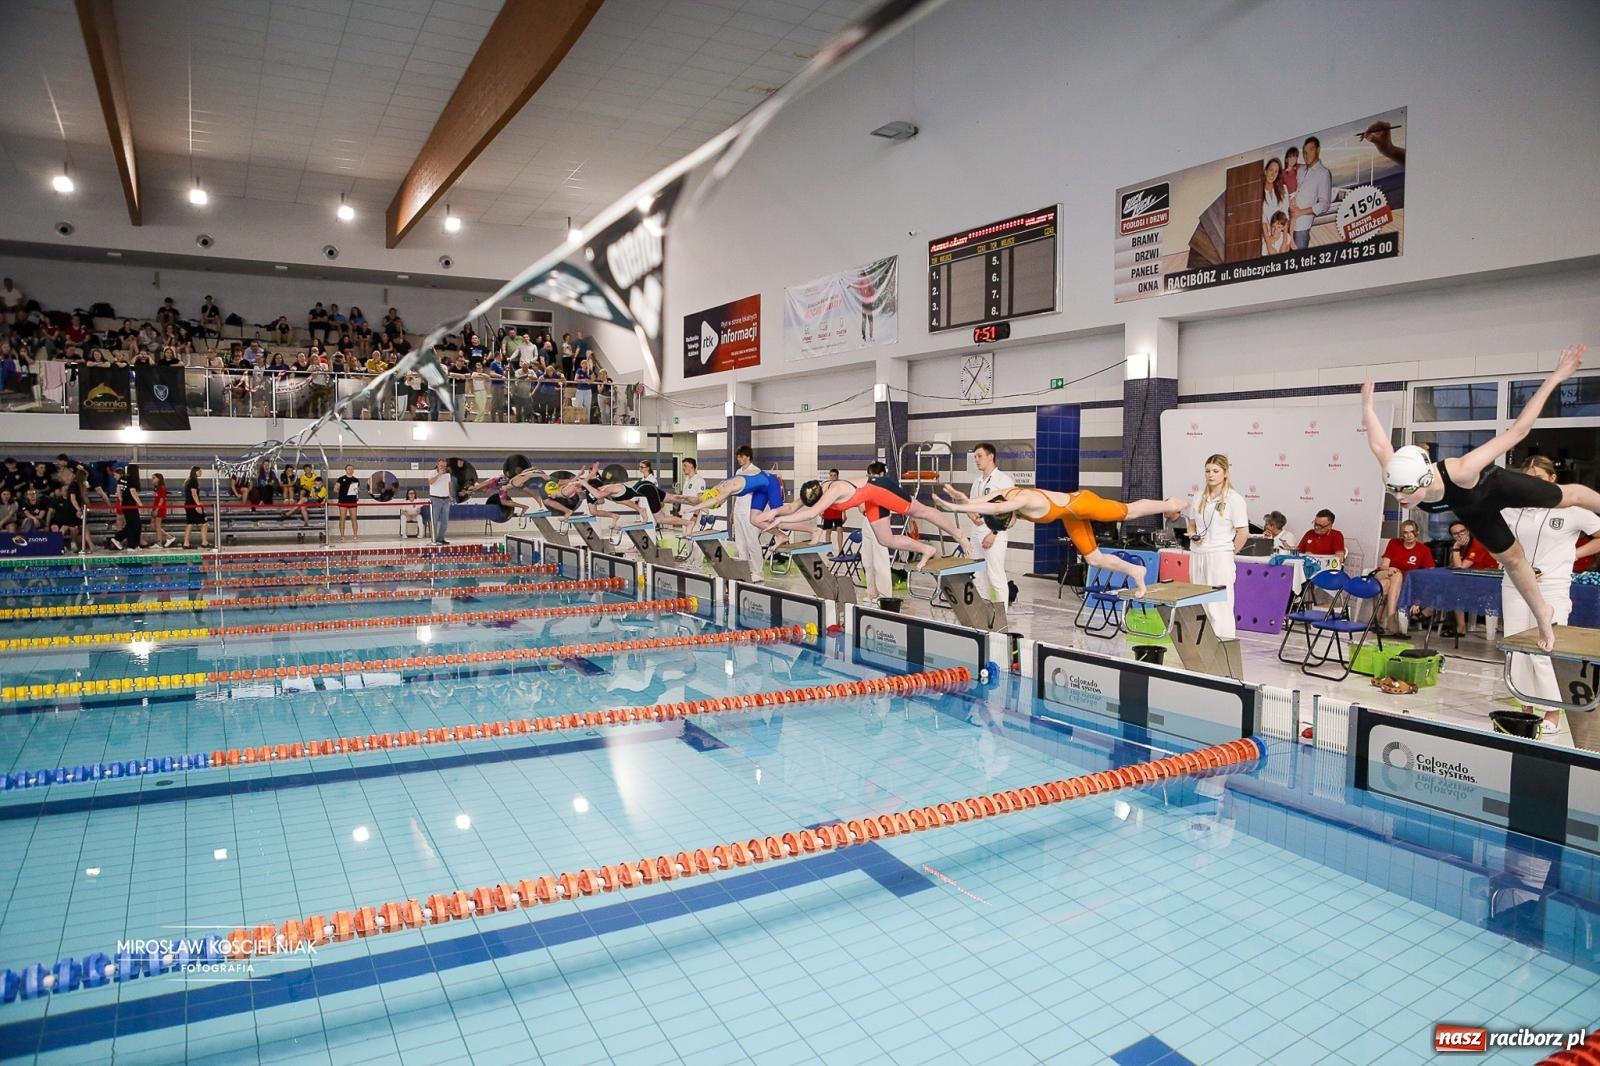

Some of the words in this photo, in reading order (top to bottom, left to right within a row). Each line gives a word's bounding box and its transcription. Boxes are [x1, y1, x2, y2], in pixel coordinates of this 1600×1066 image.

[1343, 191, 1382, 219] -15%
[1131, 232, 1160, 248] BRAMY
[1135, 248, 1159, 262] DRZWI
[1131, 264, 1159, 279] PANELE
[1167, 269, 1217, 290] RACIBÓRZ
[1220, 269, 1231, 281] ul.
[1233, 262, 1281, 279] Głubczycka
[1284, 258, 1299, 271] 13,
[1300, 255, 1317, 268] tel:
[1319, 251, 1332, 264] 32
[1340, 247, 1360, 260] 415
[1362, 244, 1376, 257] 25
[1378, 241, 1393, 254] 00
[1138, 280, 1159, 293] OKNA
[703, 335, 714, 348] rtk
[720, 322, 758, 345] informacji
[587, 527, 594, 540] 2
[641, 535, 649, 550] 3
[714, 546, 722, 563] 4
[813, 560, 823, 580] 5
[963, 581, 974, 605] 6
[1195, 614, 1207, 645] 7
[1069, 675, 1098, 689] Colorado
[1569, 681, 1594, 706] 8
[1416, 753, 1469, 774] Colorado
[1417, 763, 1437, 774] TIME
